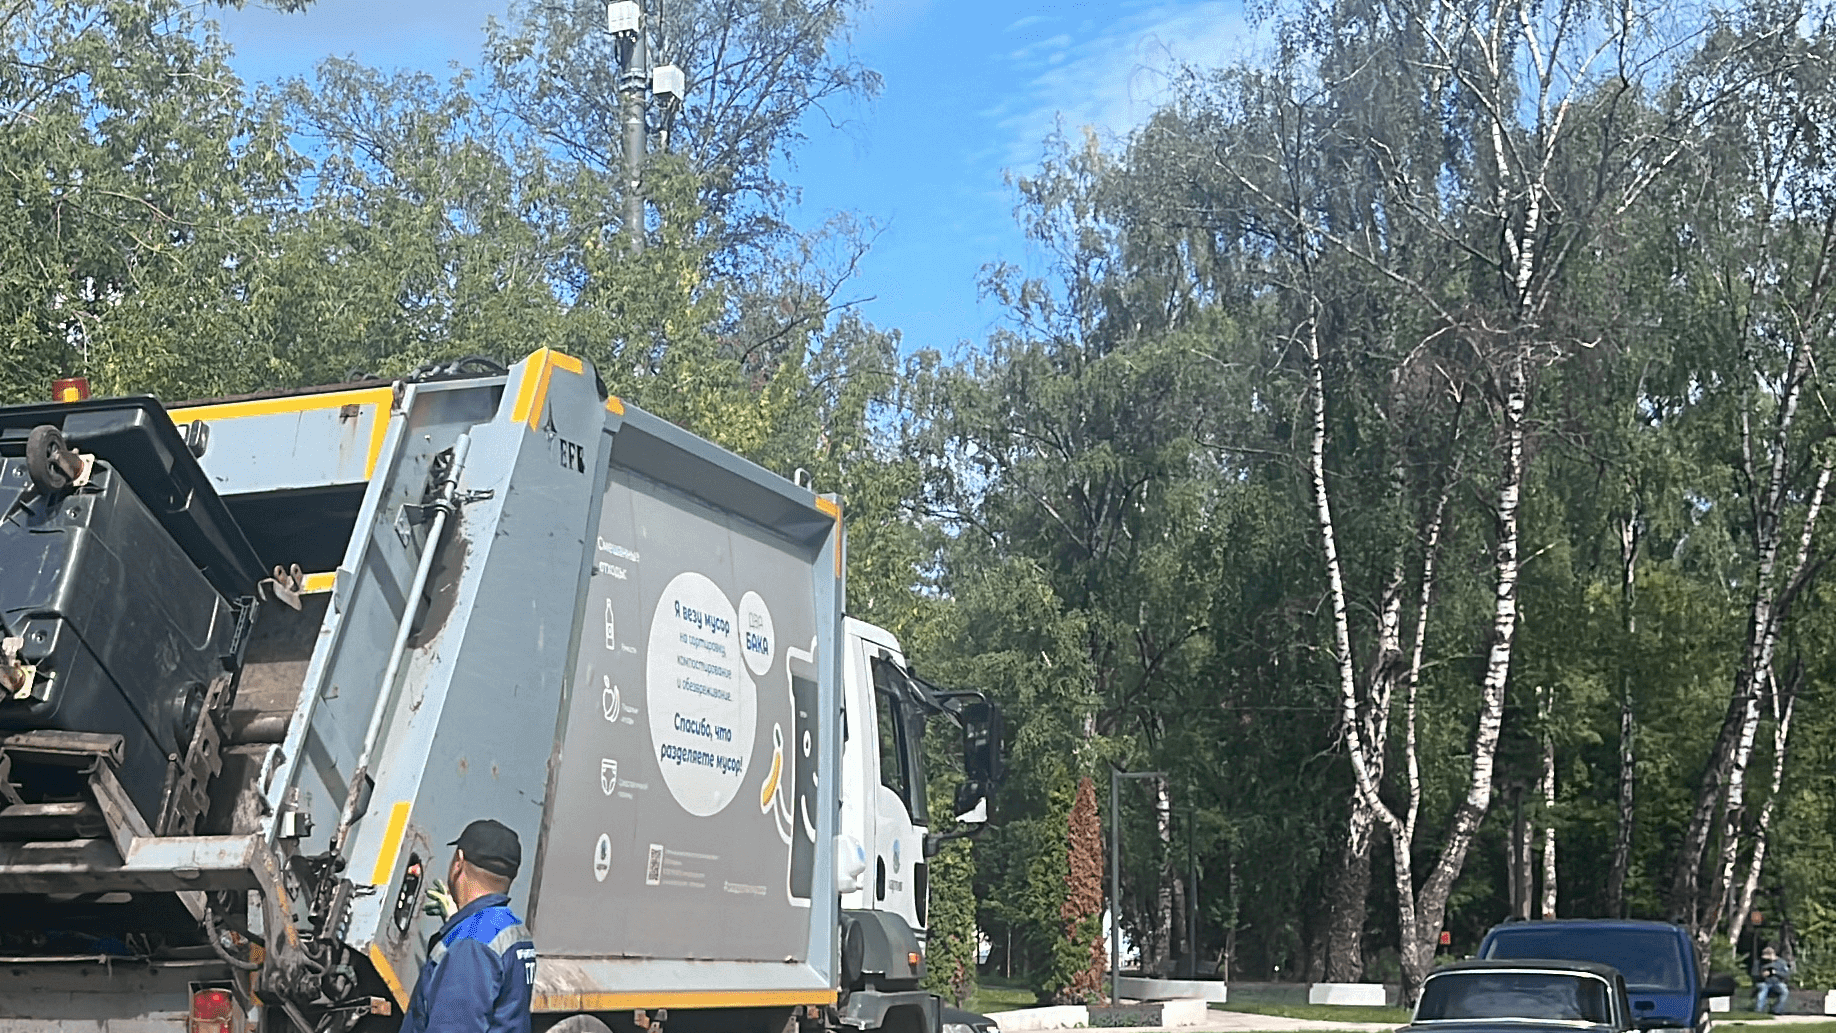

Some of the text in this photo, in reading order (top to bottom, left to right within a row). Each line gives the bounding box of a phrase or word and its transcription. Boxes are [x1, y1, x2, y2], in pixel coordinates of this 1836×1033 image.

[674, 600, 730, 638] Я везу мусор
[746, 631, 769, 655] БАКА
[674, 712, 732, 742] Спасибо, что
[660, 744, 743, 777] разделяете мусор!
